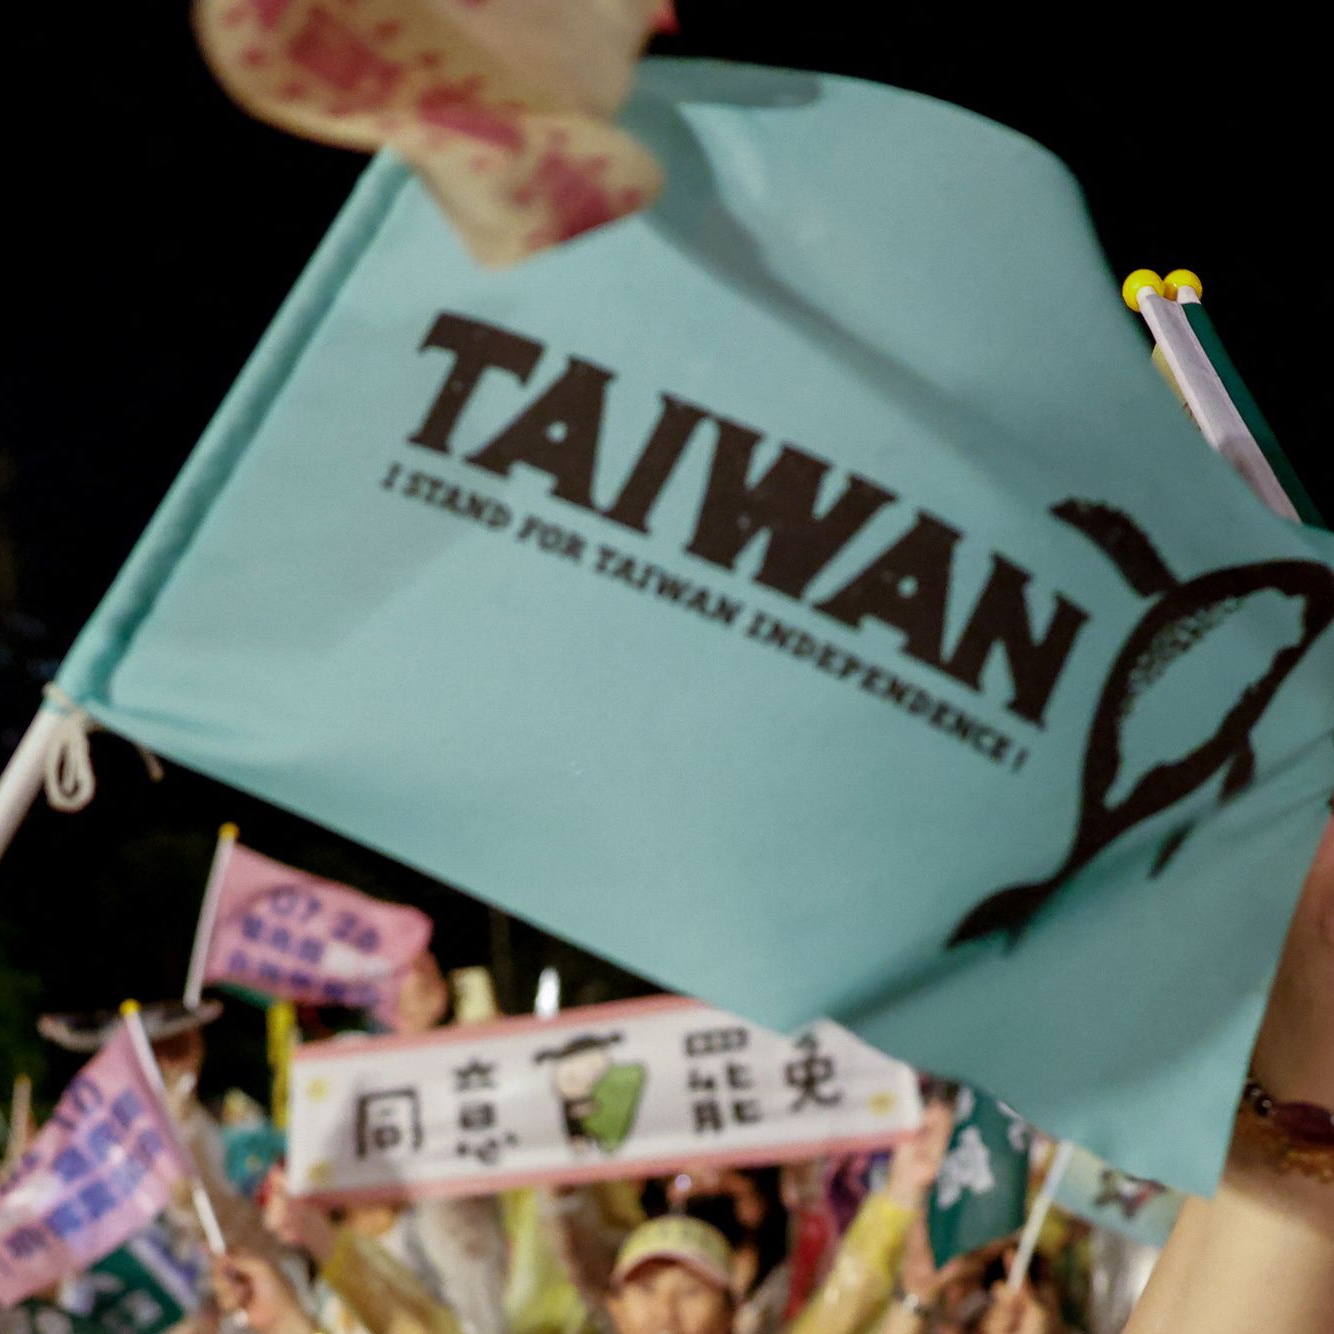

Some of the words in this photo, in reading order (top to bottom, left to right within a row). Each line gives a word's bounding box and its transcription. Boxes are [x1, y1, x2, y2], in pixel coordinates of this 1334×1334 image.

[380, 462, 401, 490] I
[403, 471, 512, 535] STAND
[515, 507, 587, 564] FOR
[592, 541, 742, 629] TAIWAN
[408, 311, 1091, 729] TAIWAN
[352, 1056, 519, 1164] 同意
[679, 1025, 843, 1137] 罷免
